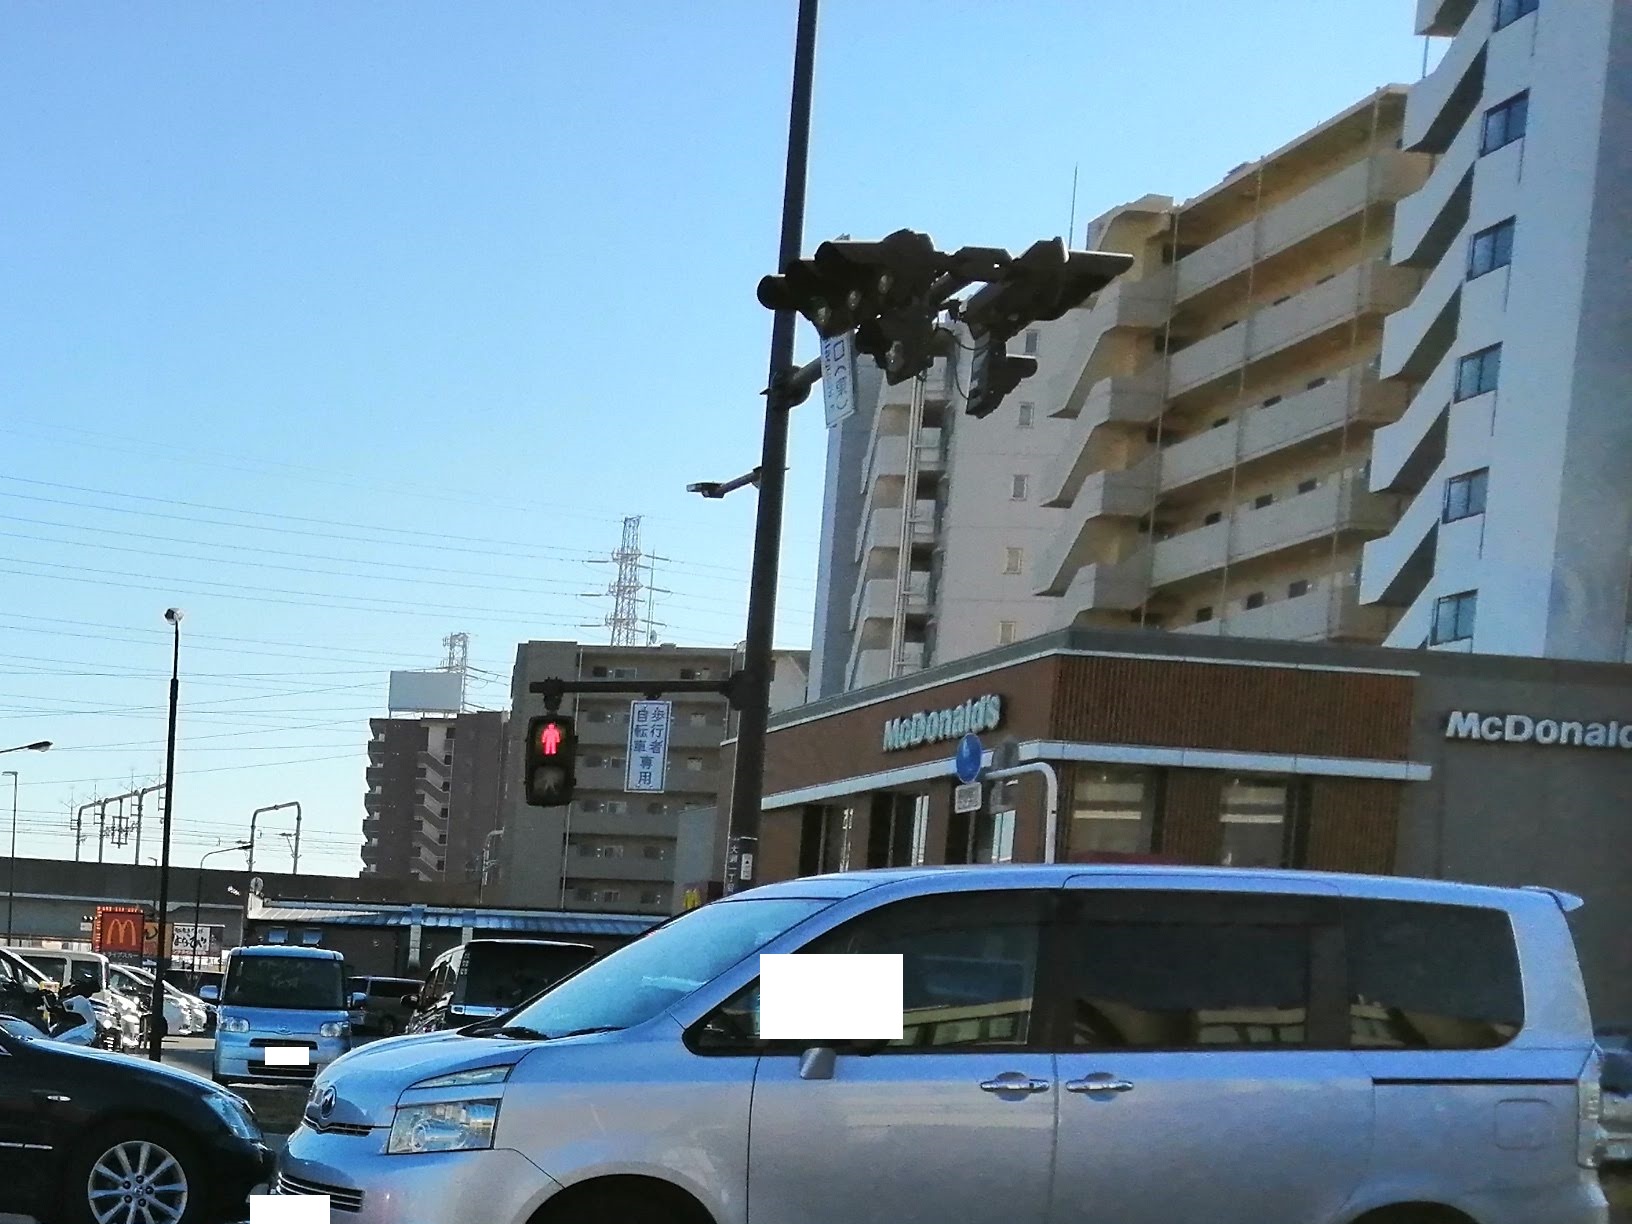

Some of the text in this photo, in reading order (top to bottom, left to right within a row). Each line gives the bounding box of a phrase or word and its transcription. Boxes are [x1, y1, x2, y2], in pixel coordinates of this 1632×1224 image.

[649, 706, 666, 754] 歩行者
[882, 694, 1001, 752] McDonald's
